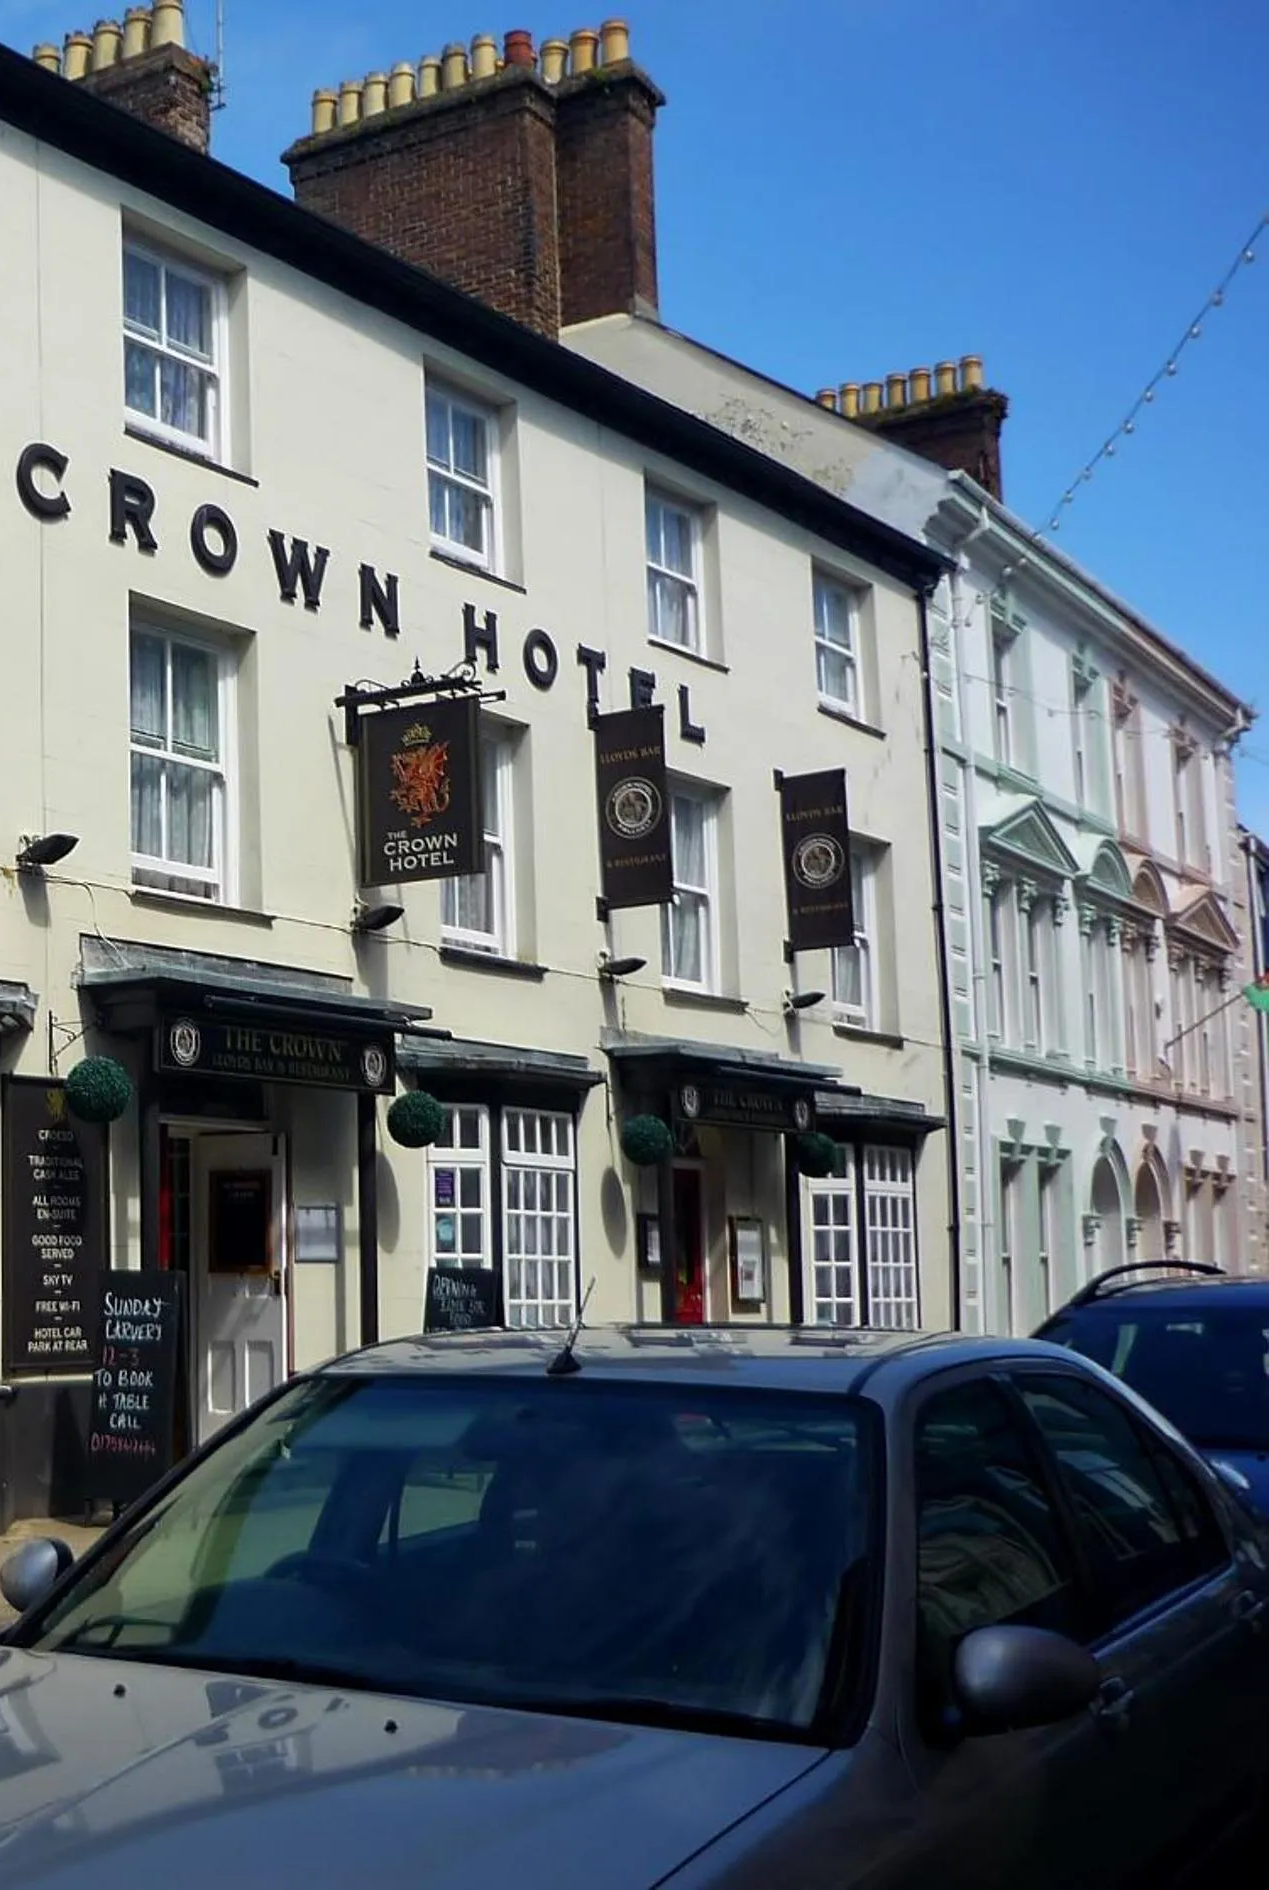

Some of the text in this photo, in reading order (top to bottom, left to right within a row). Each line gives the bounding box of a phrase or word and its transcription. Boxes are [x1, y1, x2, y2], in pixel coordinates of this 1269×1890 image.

[16, 443, 401, 638] CROWN
[387, 830, 407, 840] THE
[384, 832, 458, 855] CROWN
[390, 851, 455, 872] HOTEL
[223, 1026, 348, 1064] THE CROWN
[32, 1195, 81, 1207] ALL ROOMS
[36, 1207, 77, 1220] EN-SUITE
[31, 1234, 83, 1247] GOOD FOOD
[41, 1248, 75, 1260] SERVED
[43, 1274, 74, 1287] SKY TV
[35, 1301, 81, 1313] FREE WI-FI
[103, 1291, 163, 1318] SUNDAY
[34, 1326, 83, 1339] HOTEL CAR
[104, 1321, 163, 1342] CARVERY
[28, 1340, 88, 1353] PARK AT REAR
[94, 1368, 154, 1387] TO BOOK
[113, 1392, 150, 1411] TABLE
[109, 1412, 143, 1430] CALL
